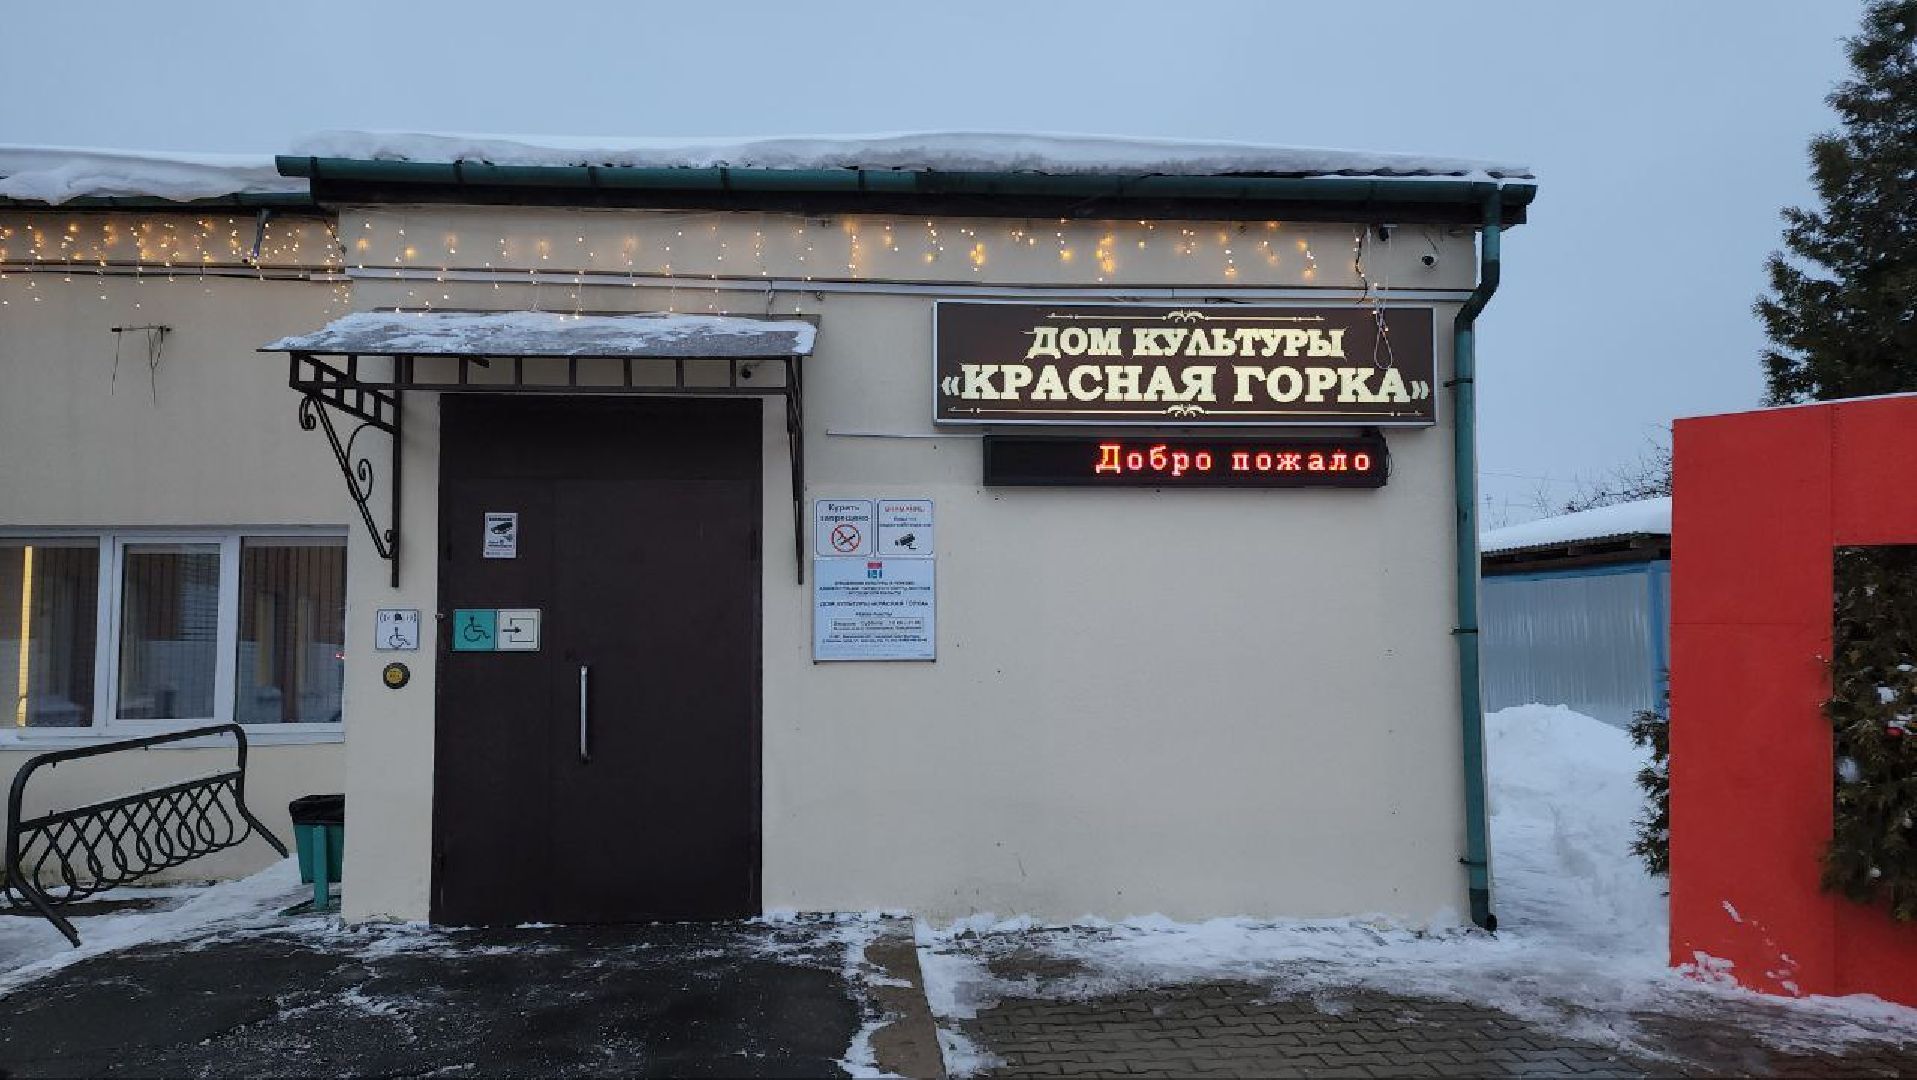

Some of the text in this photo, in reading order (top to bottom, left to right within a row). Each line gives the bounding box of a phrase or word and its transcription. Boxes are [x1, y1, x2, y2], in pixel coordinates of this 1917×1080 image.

[1024, 326, 1346, 361] ДОМ КУЛЬТУРЫ
[941, 363, 1429, 403] «КРАСНАЯ ГОРКА»
[1095, 444, 1371, 476] Добро пожало
[828, 503, 860, 513] Курить
